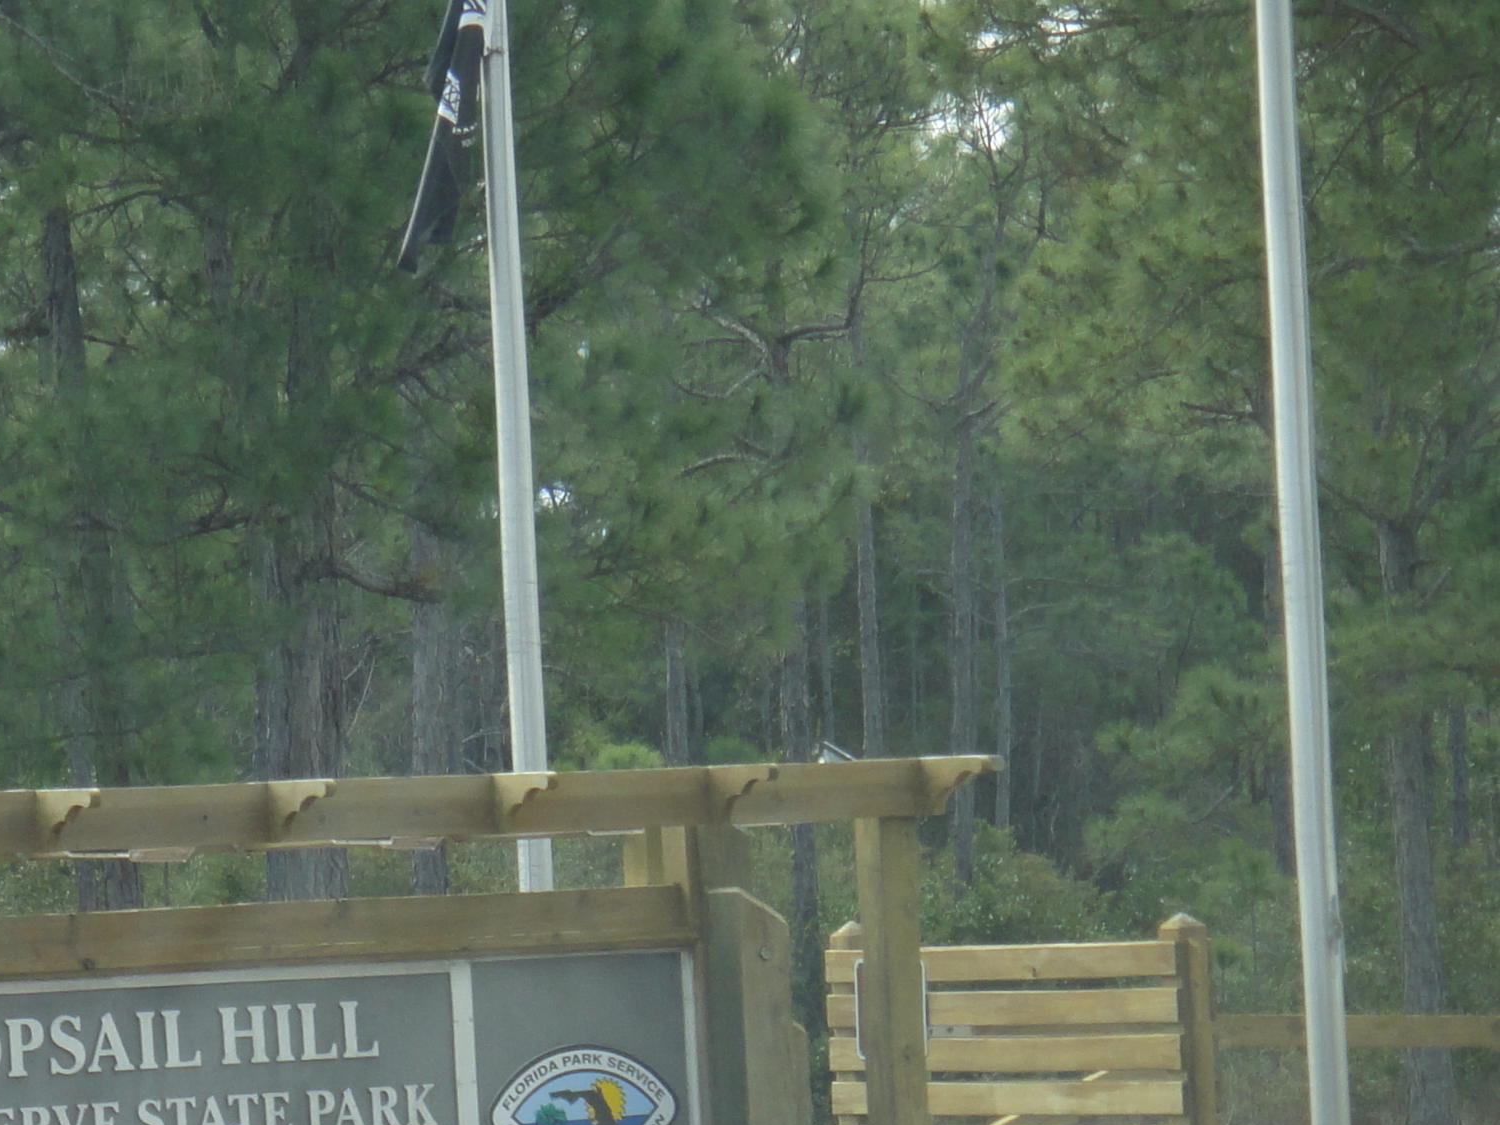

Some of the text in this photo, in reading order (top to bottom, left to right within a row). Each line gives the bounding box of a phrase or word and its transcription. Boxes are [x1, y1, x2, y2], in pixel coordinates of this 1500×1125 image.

[217, 1000, 380, 1065] HILL
[502, 1052, 667, 1112] FLORIDA PARK SERVICE
